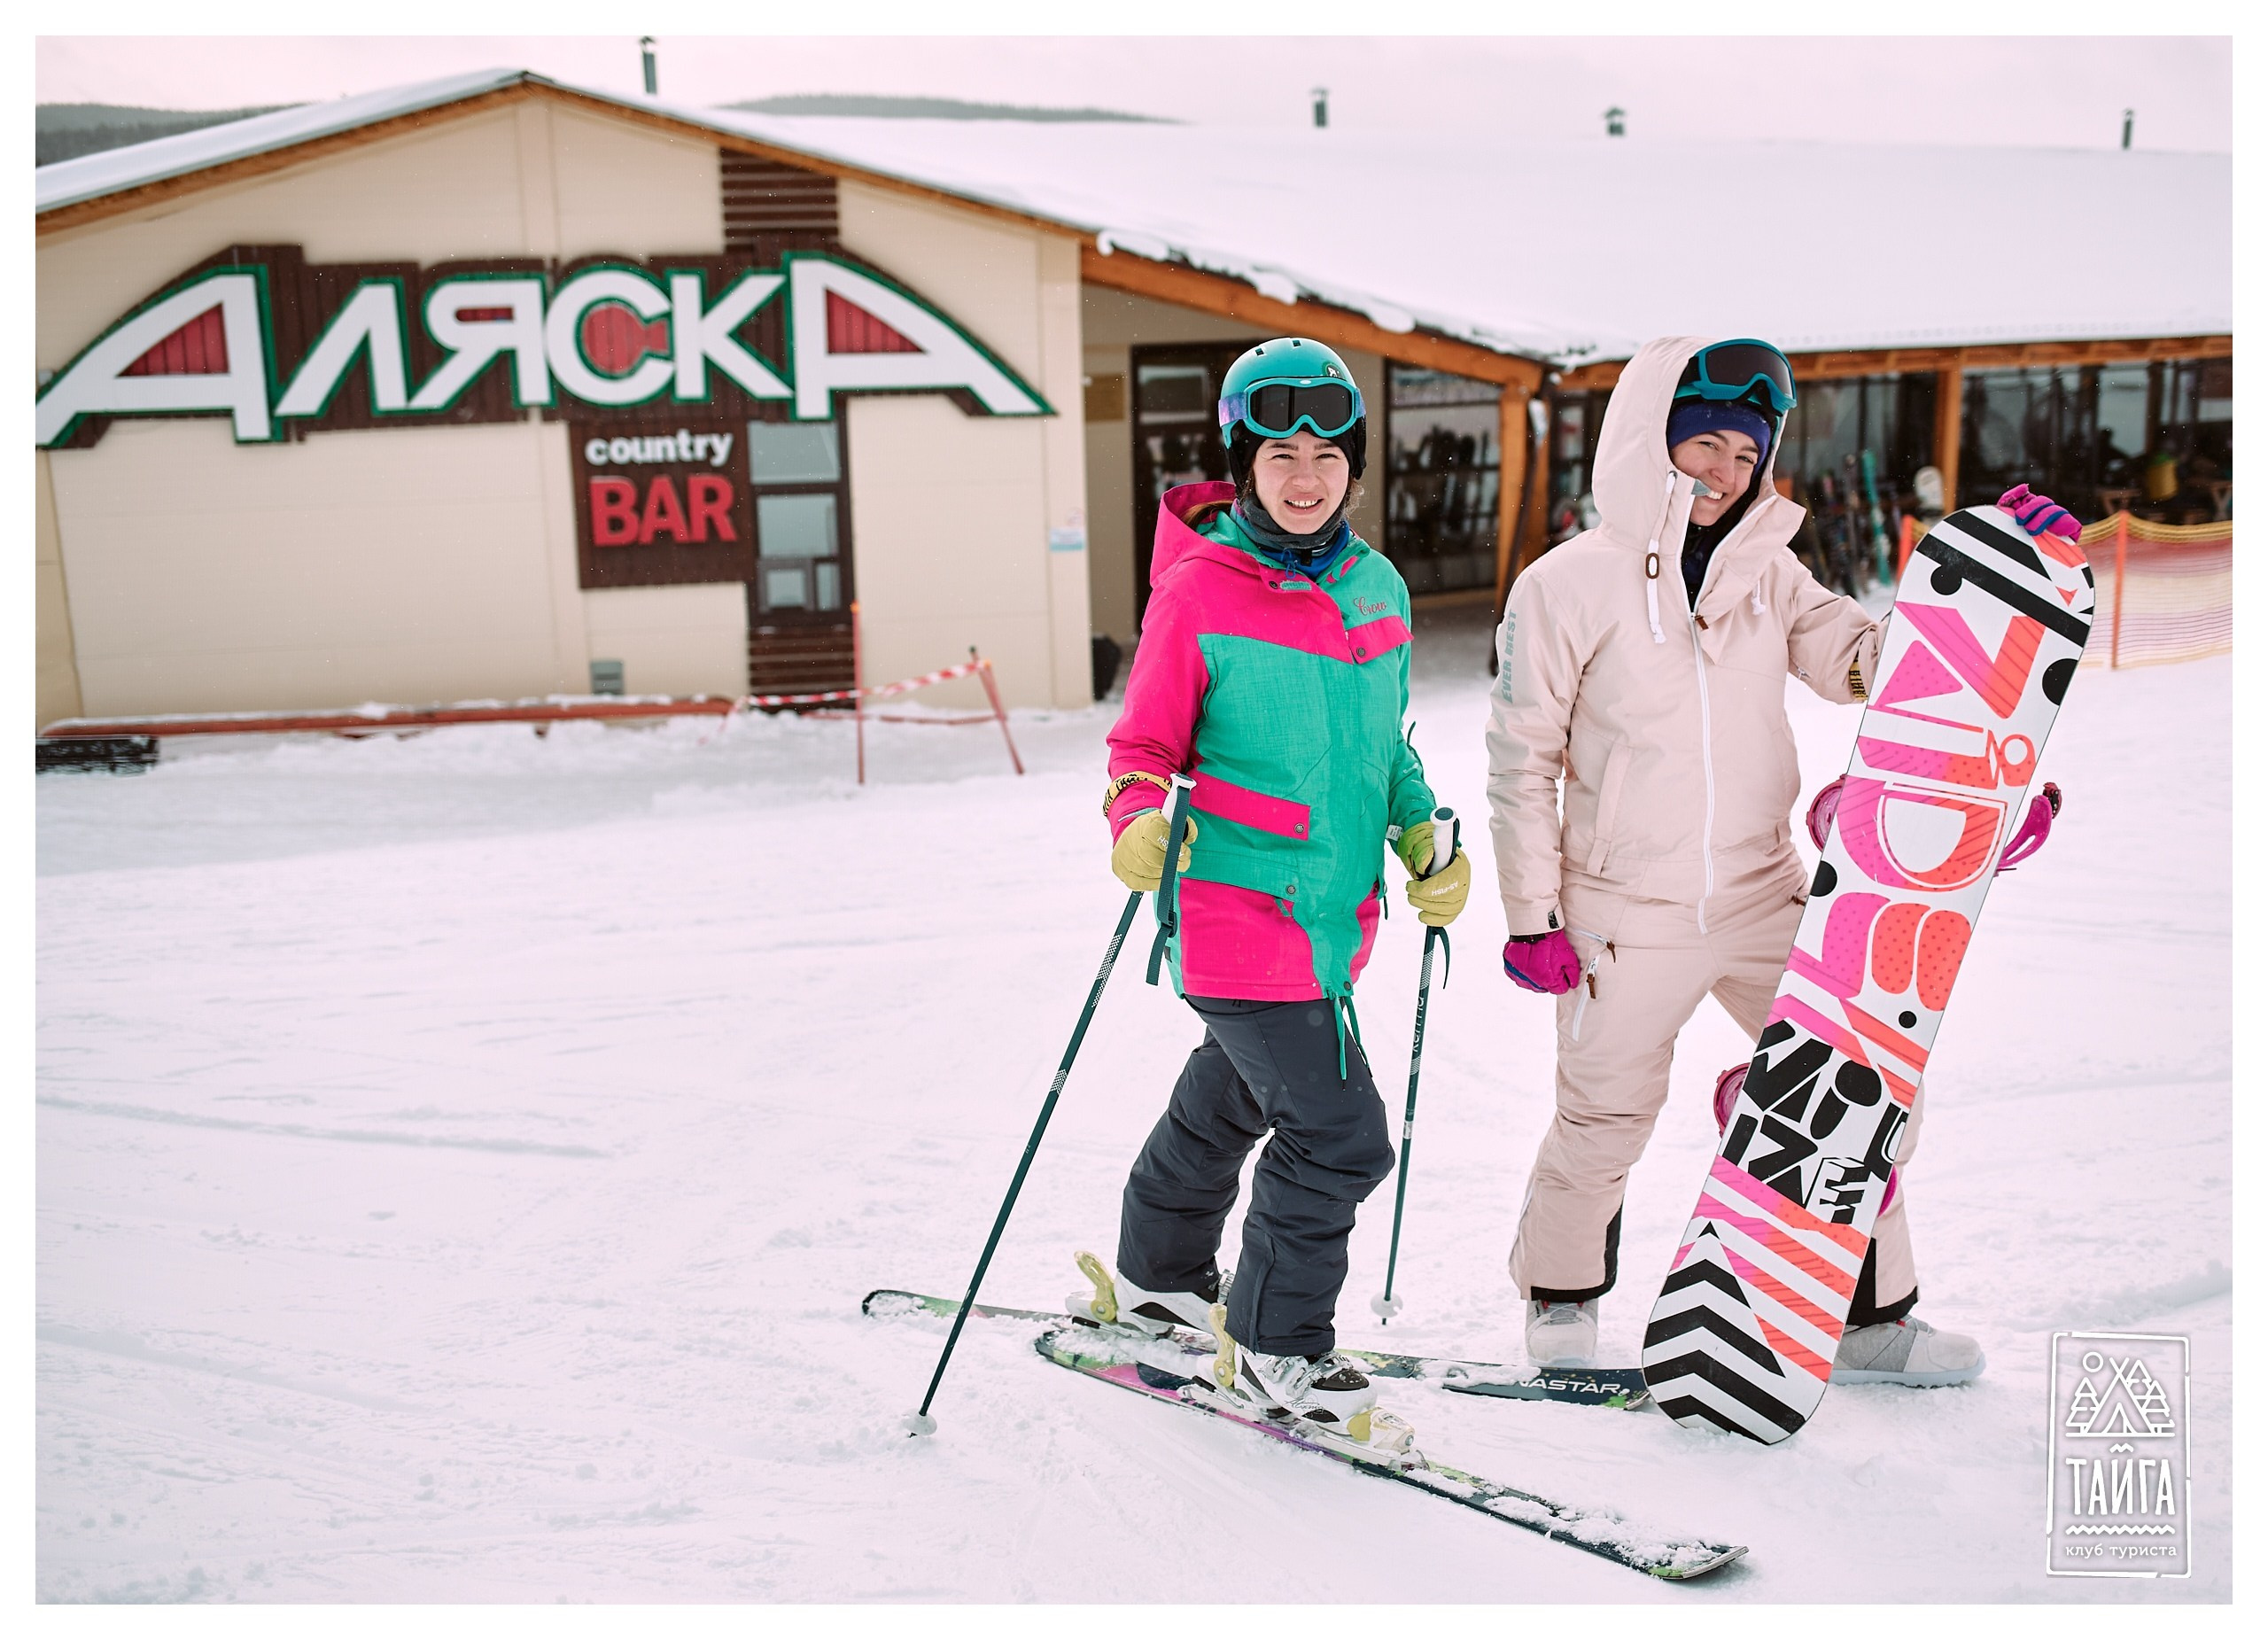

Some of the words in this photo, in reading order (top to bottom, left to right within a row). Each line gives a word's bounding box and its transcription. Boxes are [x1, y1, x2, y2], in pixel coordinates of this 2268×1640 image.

[585, 429, 734, 468] country
[589, 473, 737, 547] BAR
[1500, 660, 1513, 703] EVER
